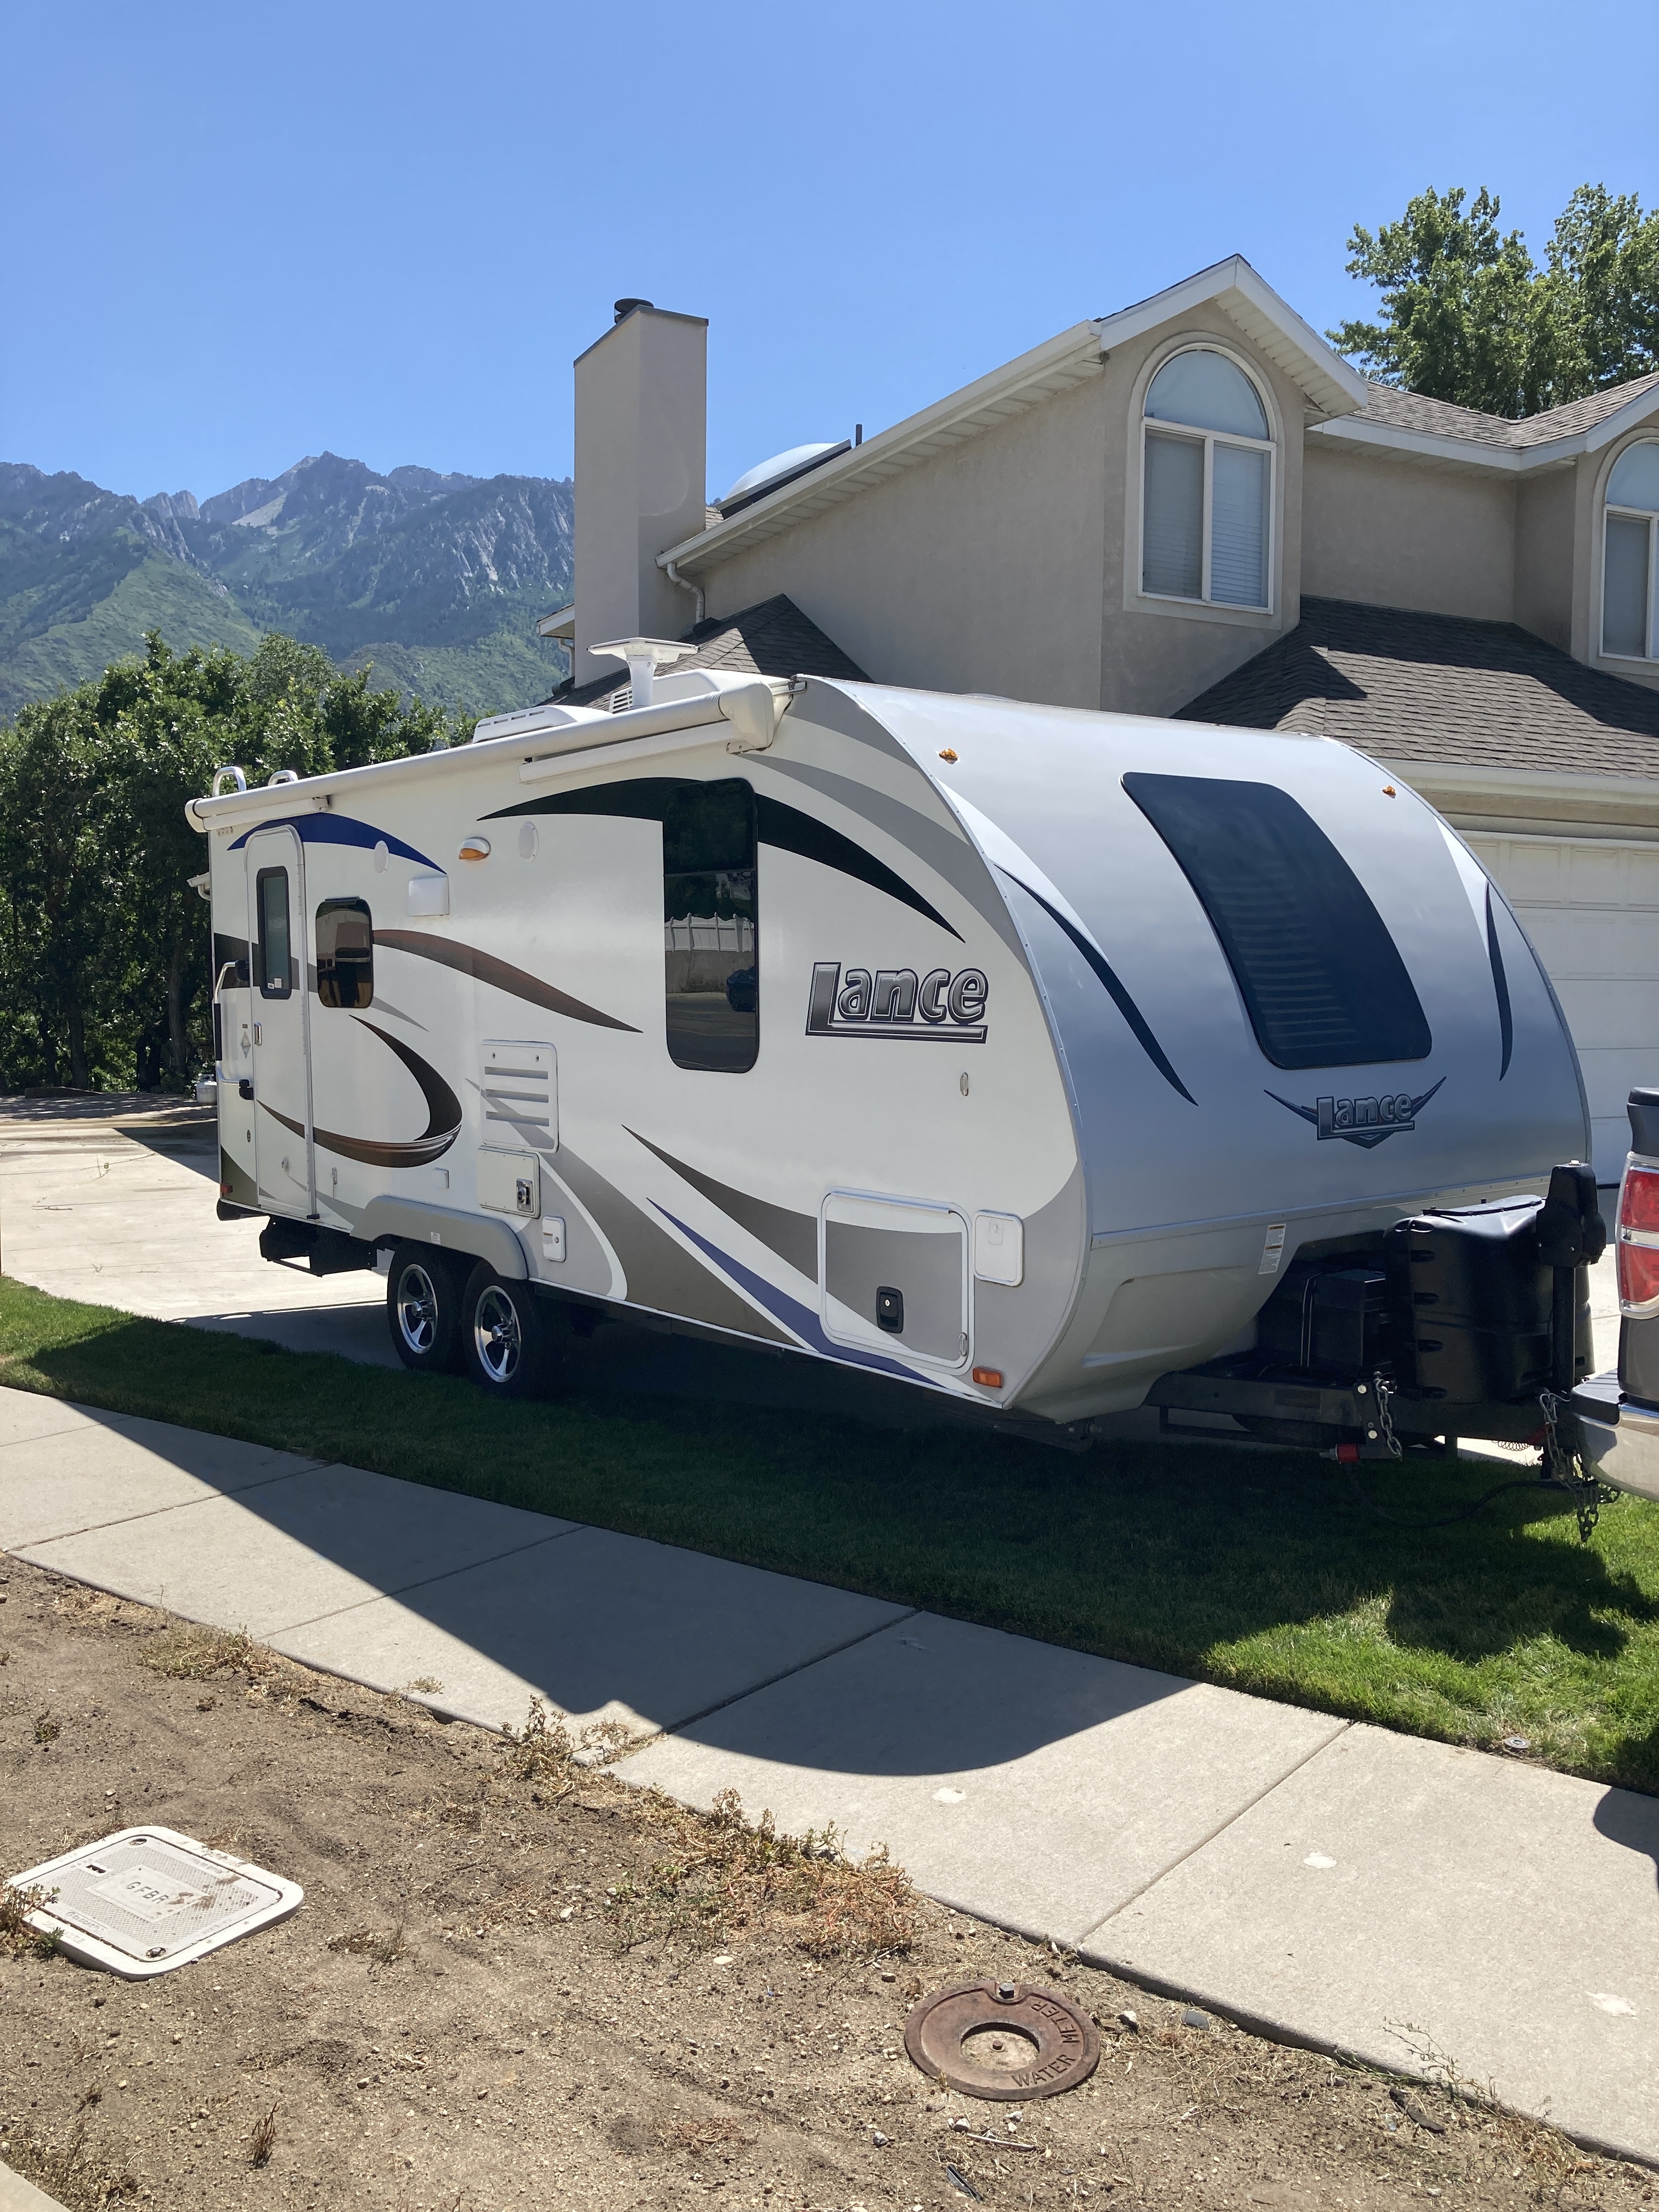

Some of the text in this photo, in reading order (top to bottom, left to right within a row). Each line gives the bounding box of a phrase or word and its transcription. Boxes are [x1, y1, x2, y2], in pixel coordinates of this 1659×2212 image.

[805, 962, 989, 1043] Lance
[1317, 1094, 1415, 1141] Lance
[126, 1881, 169, 1904] GFBR
[1011, 2000, 1080, 2087] WATER METER
